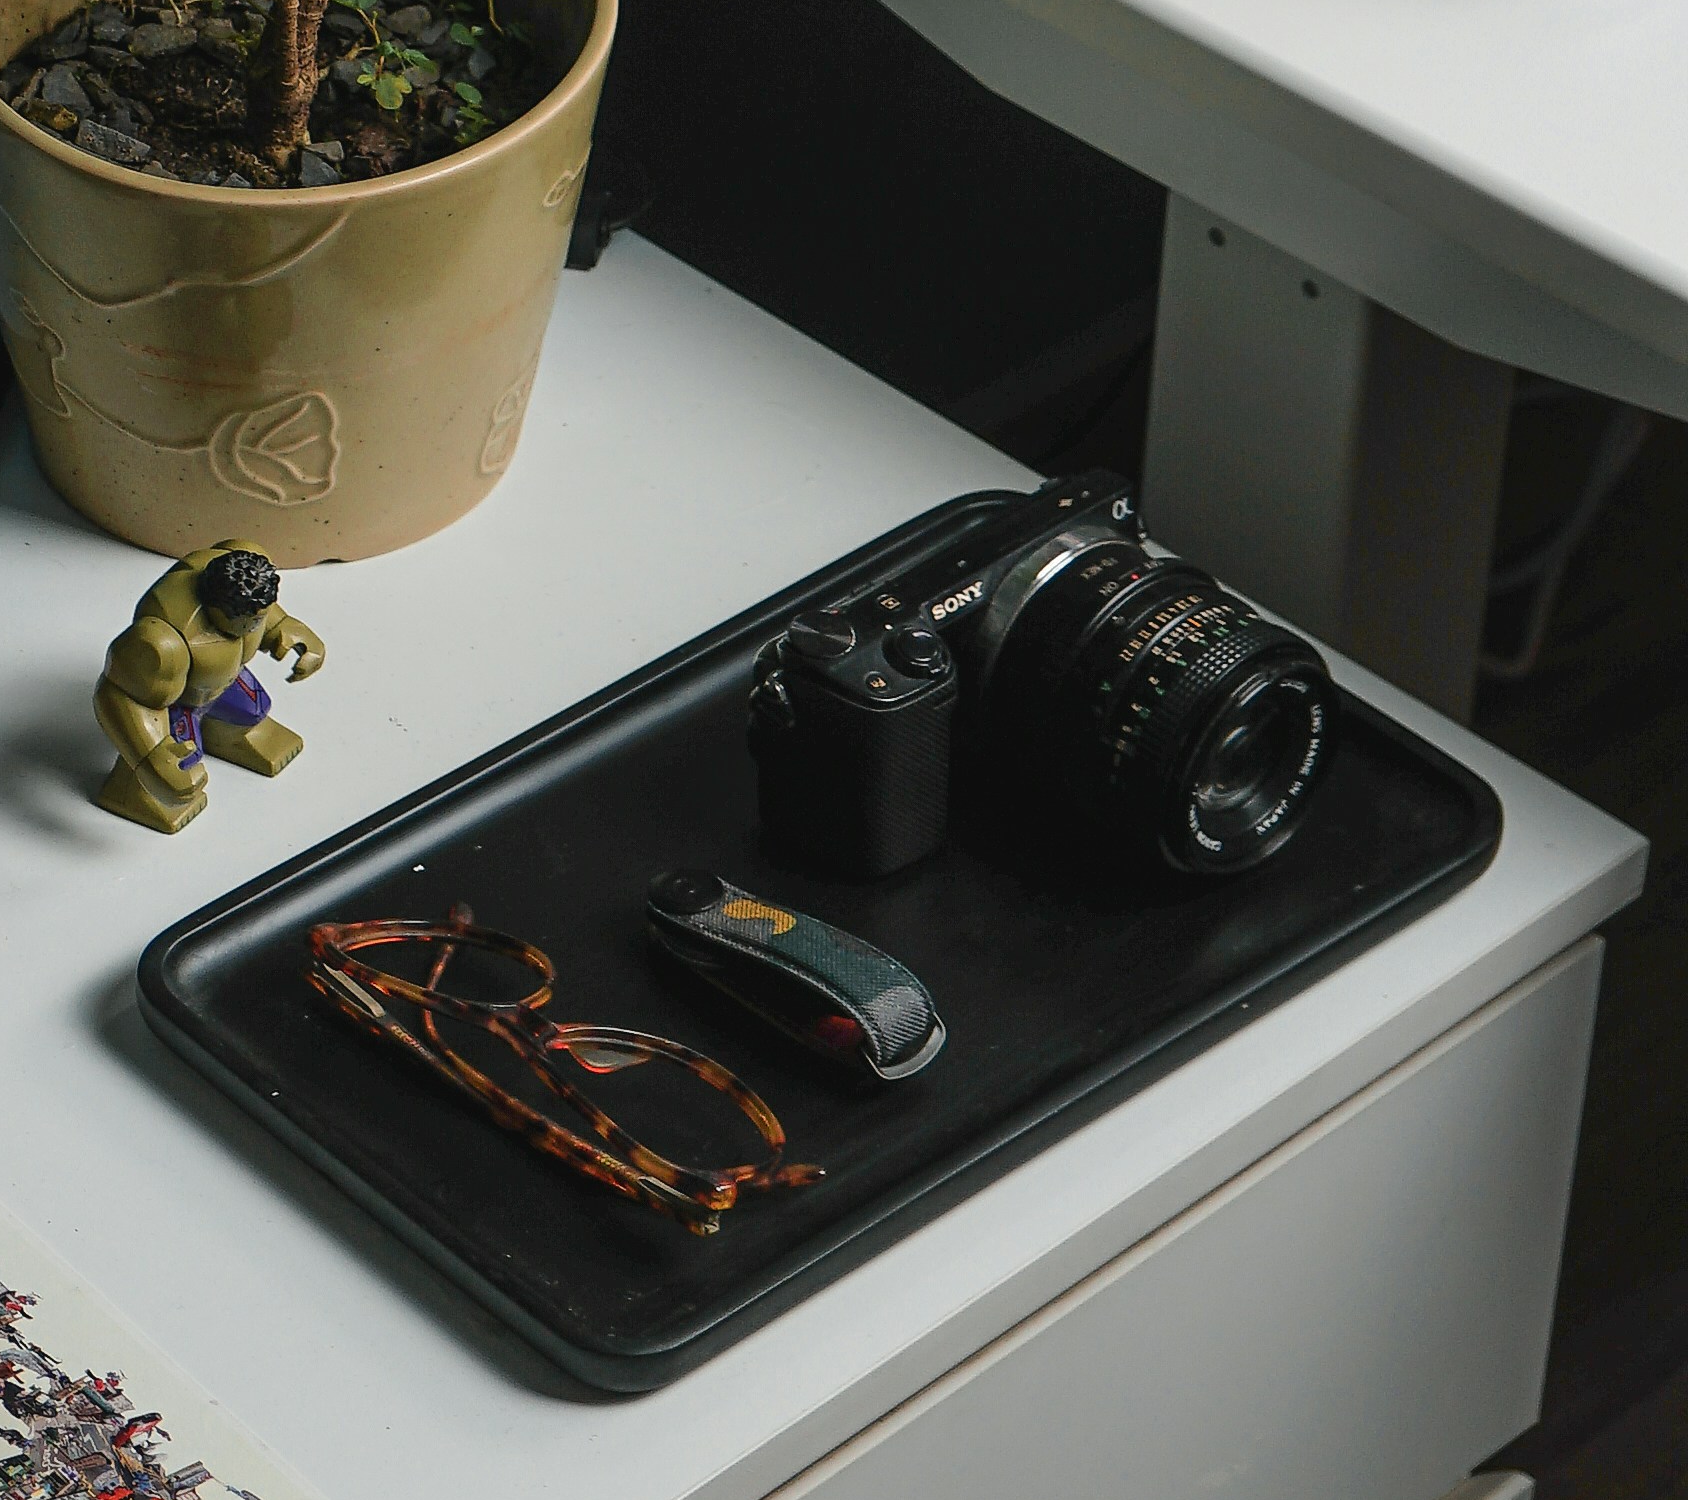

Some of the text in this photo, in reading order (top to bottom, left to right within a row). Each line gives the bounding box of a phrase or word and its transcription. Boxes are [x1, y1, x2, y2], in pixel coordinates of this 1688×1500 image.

[930, 579, 985, 622] SONY
[1255, 702, 1324, 836] LENS MADE IN JAPAN
